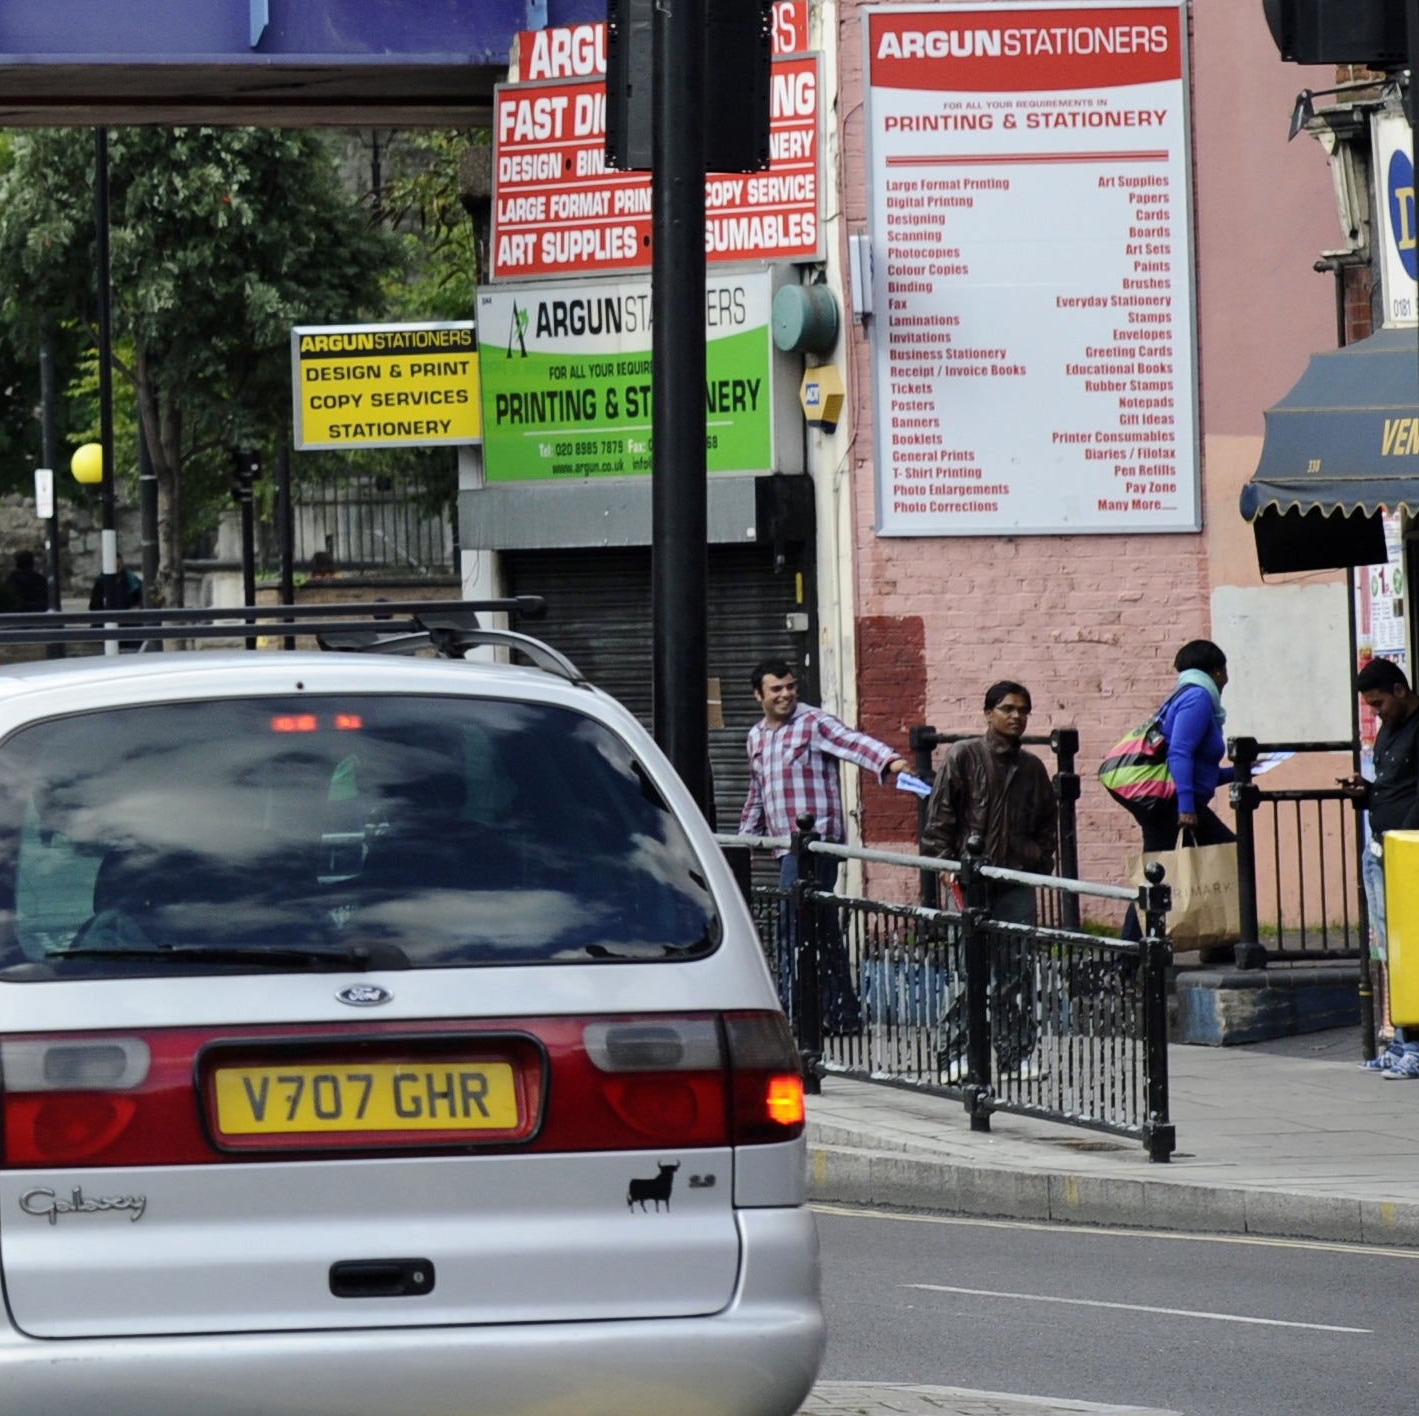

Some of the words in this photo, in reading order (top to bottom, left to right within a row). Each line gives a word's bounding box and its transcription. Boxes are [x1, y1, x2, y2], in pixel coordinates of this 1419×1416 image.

[877, 25, 1168, 60] ARGUNSTATIONERS
[943, 102, 962, 110] FOR
[986, 101, 1013, 109] YOUR
[1016, 99, 1094, 108] REQUIREMENTS
[1097, 99, 1108, 107] IN
[500, 96, 568, 143] FAST
[884, 114, 994, 132] PRINTING
[1003, 114, 1018, 129] &
[1026, 110, 1168, 129] STATIONERY
[499, 152, 562, 183] DESIGN
[886, 180, 918, 193] Large
[921, 179, 961, 191] Format
[964, 178, 1010, 191] Printing
[1098, 176, 1115, 188] Art
[1118, 175, 1169, 188] Supplies
[498, 196, 546, 224] LARGE
[550, 191, 611, 220] FORMAT
[748, 174, 815, 205] SERVICE
[887, 197, 924, 209] Digital
[928, 196, 973, 209] Printing
[1129, 192, 1170, 205] Papers
[887, 214, 945, 226] Designing
[1136, 209, 1171, 221] Cards
[888, 230, 942, 243] Scanning
[1129, 226, 1171, 238] Boards
[498, 233, 537, 267] ART
[542, 226, 637, 264] SUPPLIES
[1126, 243, 1143, 255] Art
[1146, 243, 1171, 255] Sets
[888, 247, 960, 260] Photocopies
[888, 264, 925, 276] Colour
[929, 264, 969, 276] Copies
[1134, 260, 1171, 272] Paints
[888, 281, 933, 294] Binding
[1122, 278, 1171, 290] Brushes
[888, 298, 907, 310] Fax
[1056, 296, 1108, 309] Everyday
[1111, 294, 1172, 307] Stationery
[889, 315, 960, 327] Laminations
[1128, 311, 1172, 324] Stamps
[889, 332, 951, 344] Invitations
[1113, 328, 1173, 341] Envelopes
[301, 330, 473, 353] ARGUNSTATIONERS
[890, 350, 943, 361] Business
[946, 348, 1007, 360] Stationery
[1085, 346, 1136, 359] Greeting
[1138, 345, 1173, 357] Cards
[306, 365, 381, 382] DESIGN
[389, 364, 403, 378] &
[410, 361, 469, 377] PRINT
[549, 366, 567, 380] FOR
[570, 364, 586, 379] ALL
[589, 362, 614, 378] YOUR
[890, 366, 934, 378] Receipt
[945, 366, 988, 377] Invoice
[991, 364, 1027, 376] Books
[1066, 363, 1135, 375] Educational
[1138, 362, 1173, 374] Books
[891, 383, 933, 395] Tickets
[1085, 380, 1127, 392] Rubber
[1130, 379, 1174, 392] Stamps
[310, 393, 363, 410] COPY
[371, 389, 469, 407] SERVICES
[496, 389, 597, 425] PRINTING
[605, 387, 619, 420] &
[891, 400, 935, 412] Posters
[1119, 396, 1174, 409] Notepads
[892, 417, 940, 428] Banners
[1119, 413, 1139, 425] Gift
[1142, 413, 1175, 425] Ideas
[329, 420, 452, 438] STATIONERY
[892, 433, 943, 445] Booklets
[1052, 432, 1092, 444] Printer
[1095, 430, 1175, 443] Consumables
[538, 443, 553, 458] Tel:
[555, 442, 572, 456] 020
[575, 441, 598, 455] 8985
[627, 439, 646, 453] Fax:
[1085, 448, 1127, 460] Diaries
[1137, 447, 1176, 459] Filofax
[893, 450, 938, 462] General
[941, 450, 975, 461] Prints
[552, 457, 624, 476] www.argun.co.uk
[893, 468, 902, 479] T-
[905, 467, 933, 479] Shirt
[936, 466, 982, 479] Printing
[1114, 465, 1136, 477] Pen
[1139, 464, 1176, 476] Refills
[894, 484, 926, 496] Photo
[929, 483, 1010, 496] Enlargements
[1126, 482, 1146, 494] Pay
[1149, 481, 1177, 493] Zone
[894, 502, 927, 513] Photo
[930, 500, 999, 512] Corrections
[1098, 499, 1129, 512] Many
[347, 985, 381, 1004] Ford
[243, 1074, 373, 1123] V707
[393, 1072, 490, 1120] GHR
[19, 1185, 147, 1225] Galaxy
